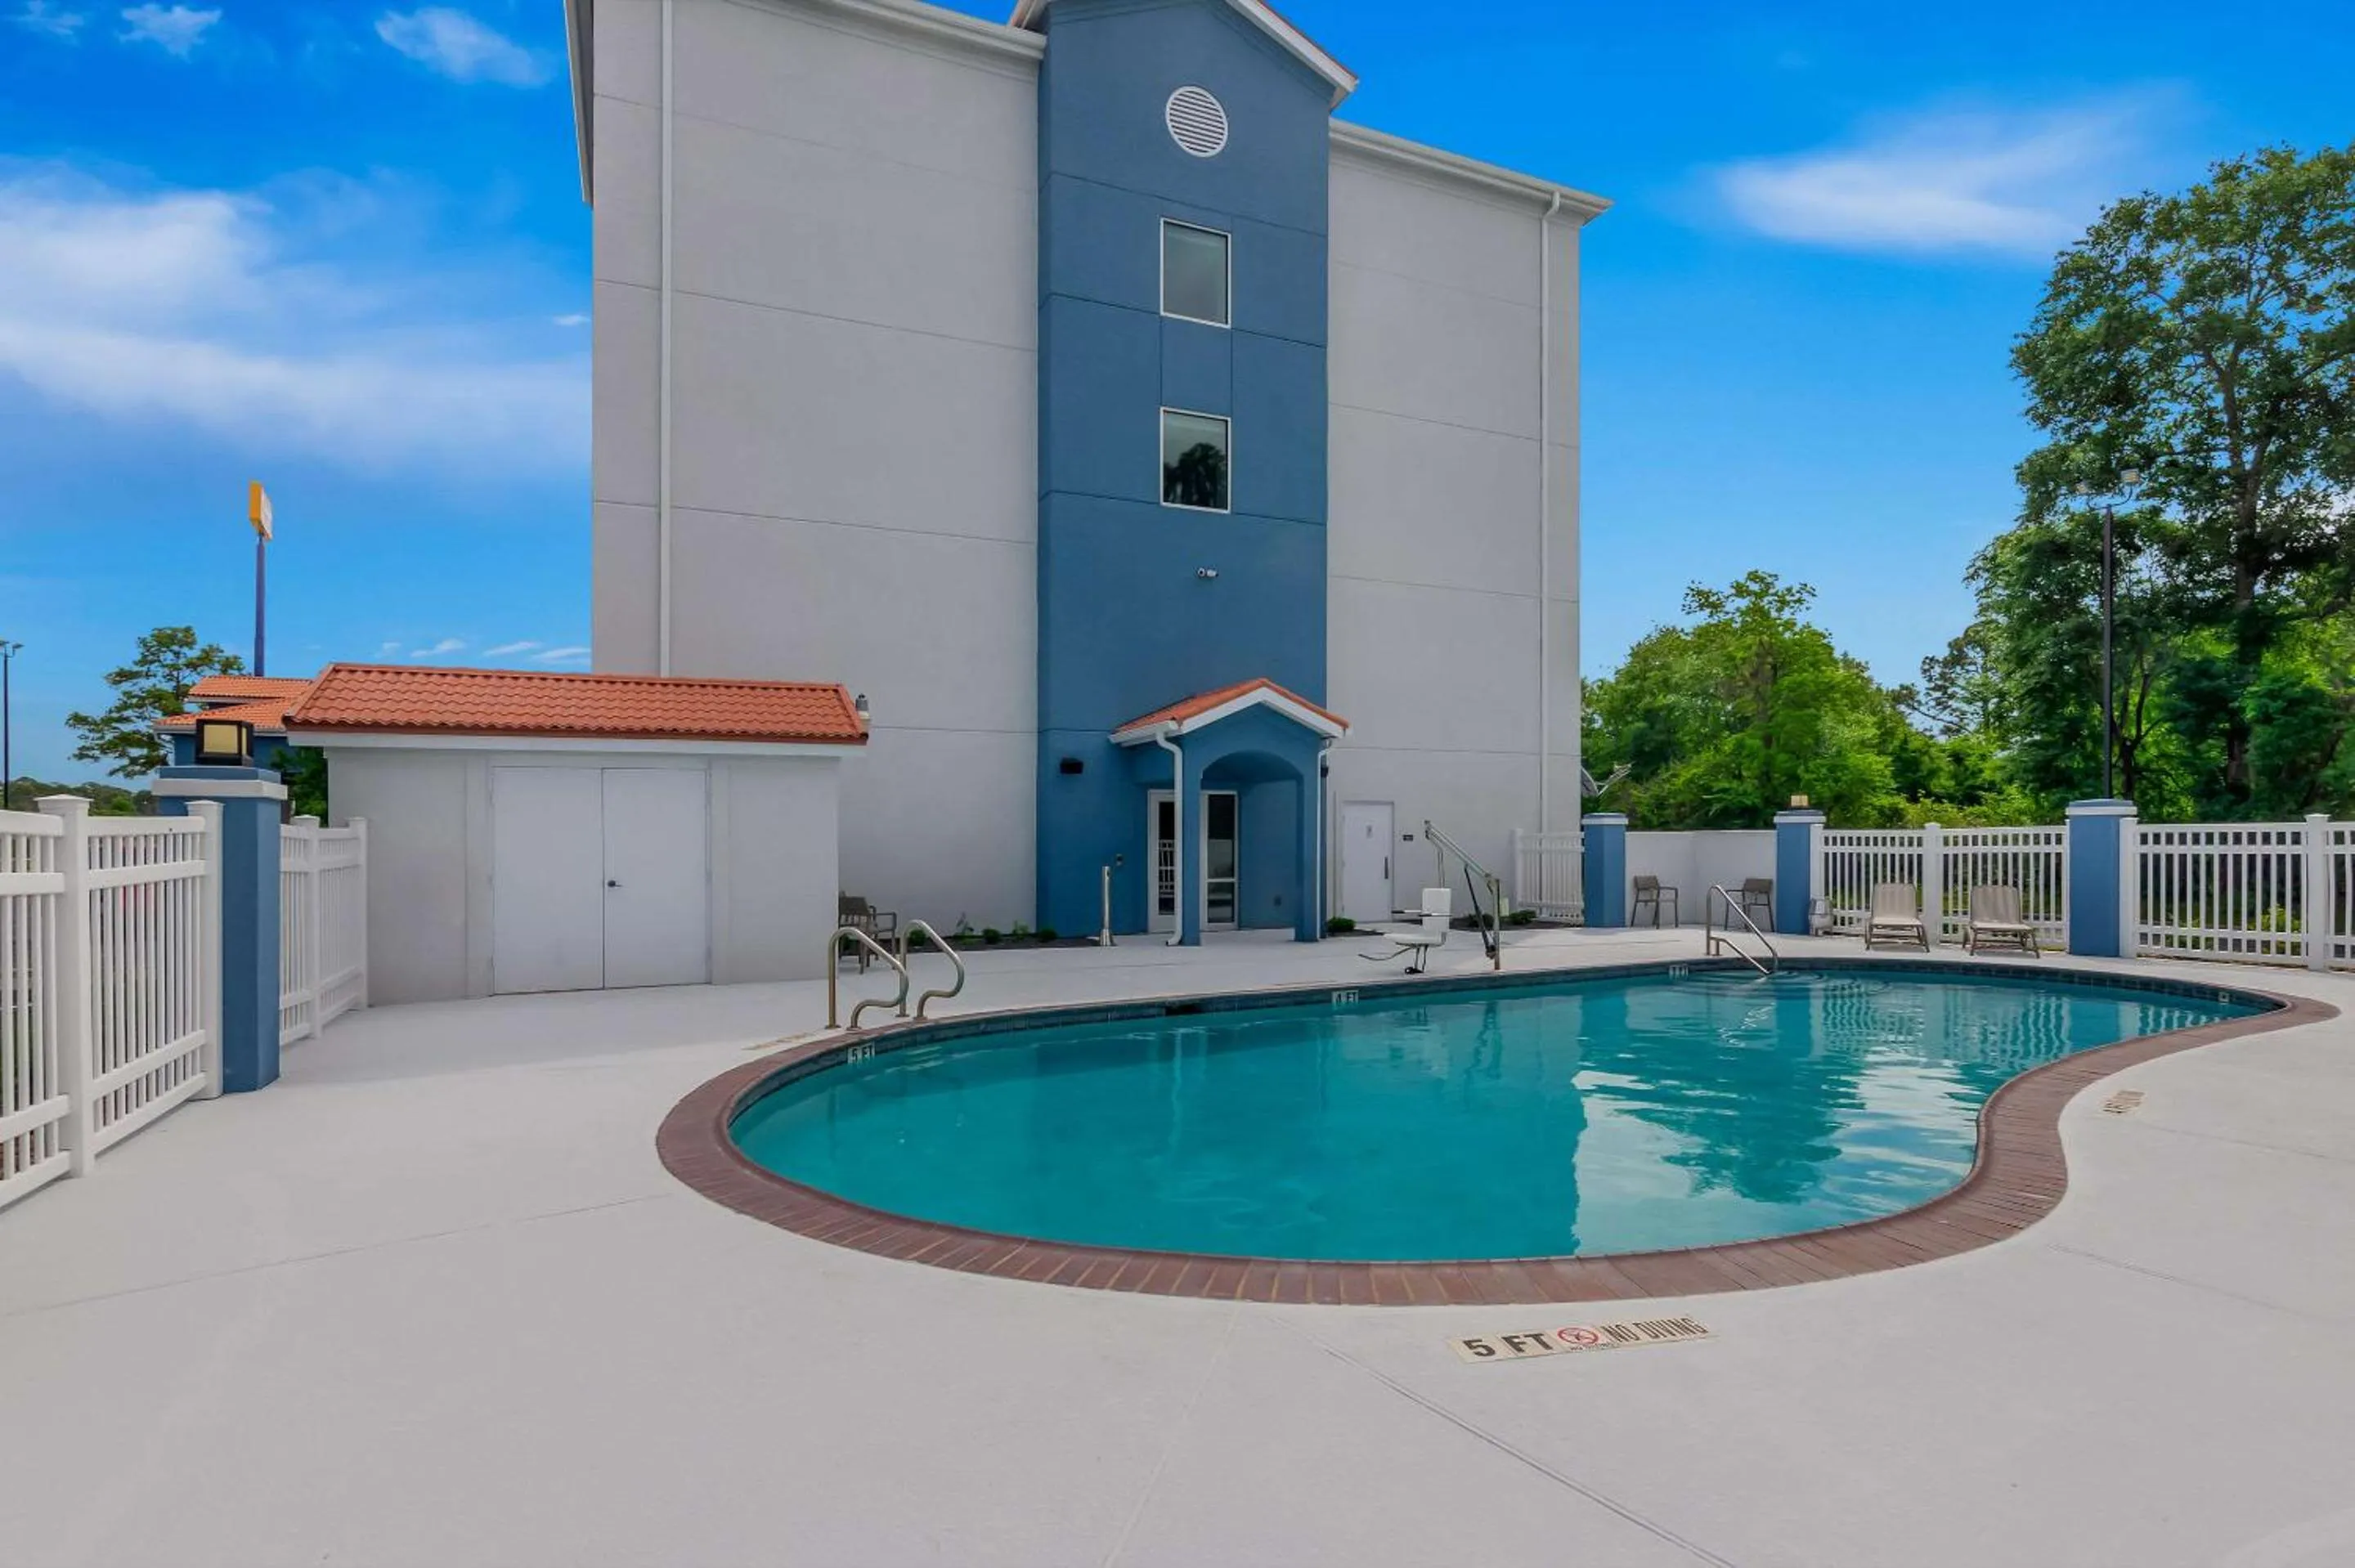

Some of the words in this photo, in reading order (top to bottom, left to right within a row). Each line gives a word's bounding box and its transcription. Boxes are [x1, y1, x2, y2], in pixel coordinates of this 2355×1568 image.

[1462, 1338, 1496, 1357] 5
[1501, 1333, 1554, 1353] FT
[1600, 1324, 1640, 1342] NO
[1632, 1317, 1710, 1340] DIVING
